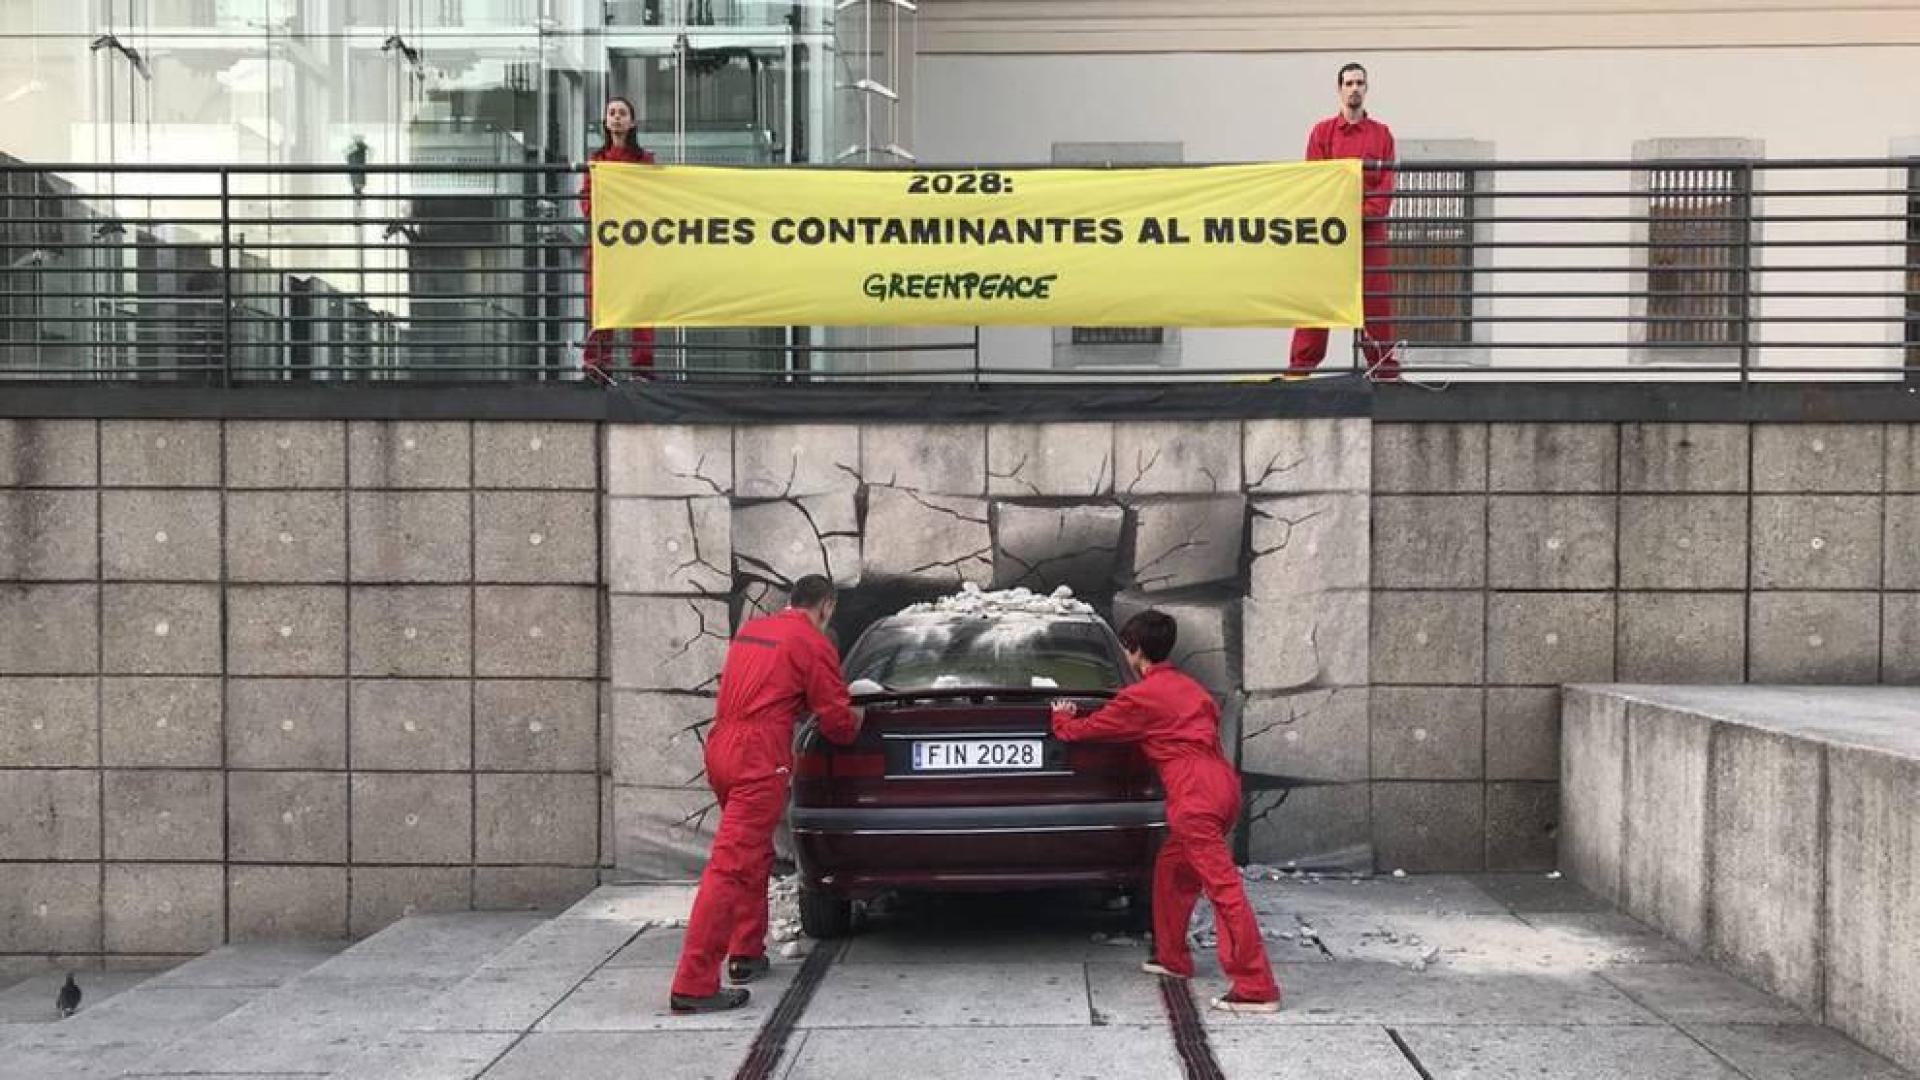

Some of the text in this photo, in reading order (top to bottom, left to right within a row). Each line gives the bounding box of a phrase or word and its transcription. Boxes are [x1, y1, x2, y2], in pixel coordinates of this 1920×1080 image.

[908, 173, 1013, 194] 2028:
[597, 216, 1347, 247] COCHES CONTAMINANTES AL MUSEO
[863, 272, 1058, 302] GREENPEACE
[928, 743, 1034, 765] FIN 2028
